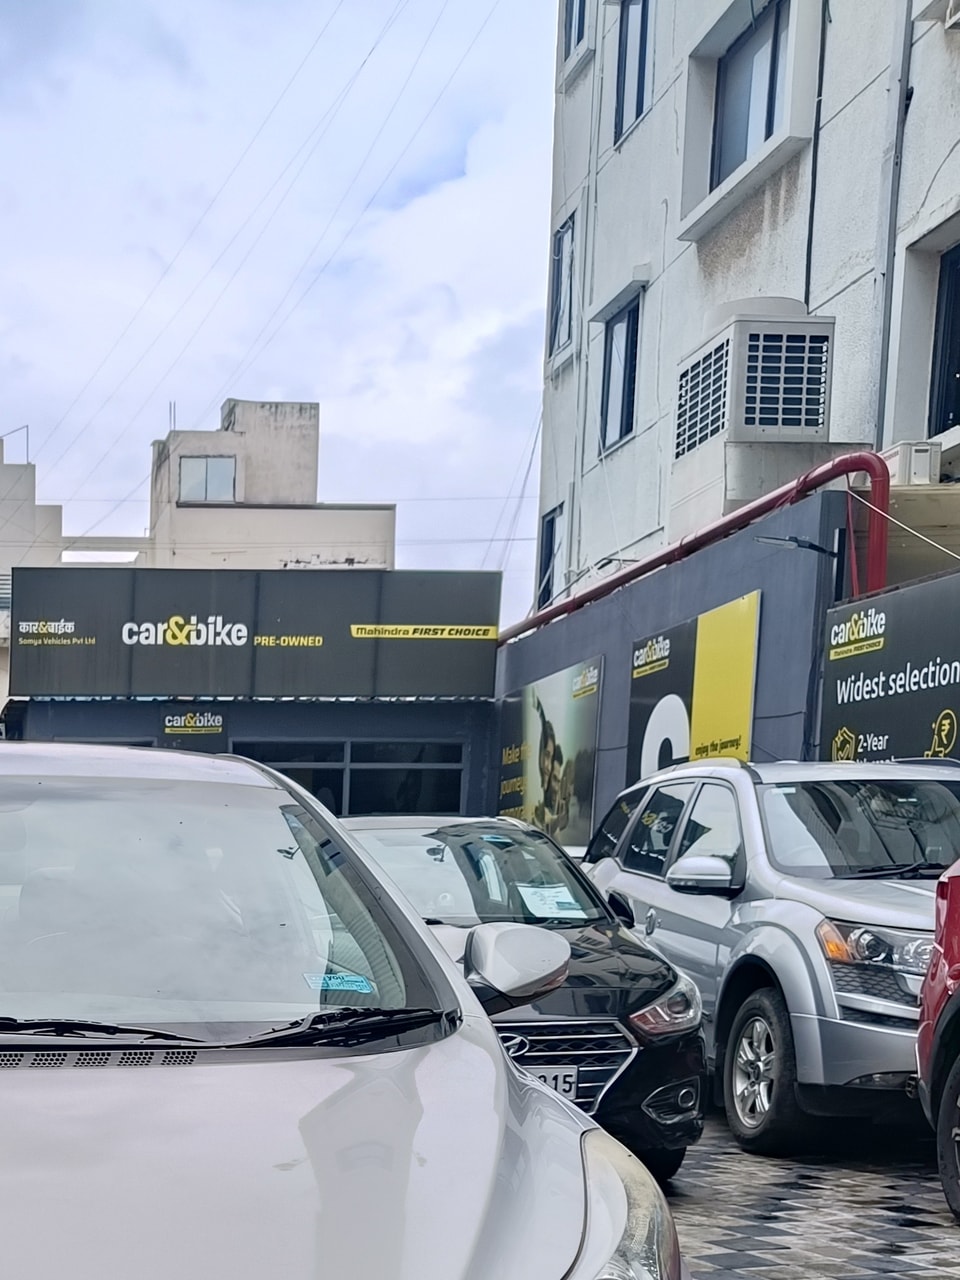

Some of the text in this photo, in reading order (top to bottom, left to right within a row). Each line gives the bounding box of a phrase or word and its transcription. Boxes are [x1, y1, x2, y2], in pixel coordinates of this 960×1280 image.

[122, 615, 248, 646] car&bike
[356, 627, 491, 637] Mahindra FIRST CHOICE
[831, 608, 886, 646] car&bike
[43, 636, 70, 645] Vehicles
[85, 636, 95, 645] Ltd
[254, 635, 323, 647] PRE-OWNED
[633, 636, 670, 667] car&bike
[836, 657, 960, 704] Widest selection
[165, 712, 223, 727] car&bike
[695, 735, 742, 757] enjoy the journey!
[858, 735, 889, 752] 2-Year
[502, 744, 521, 765] Make
